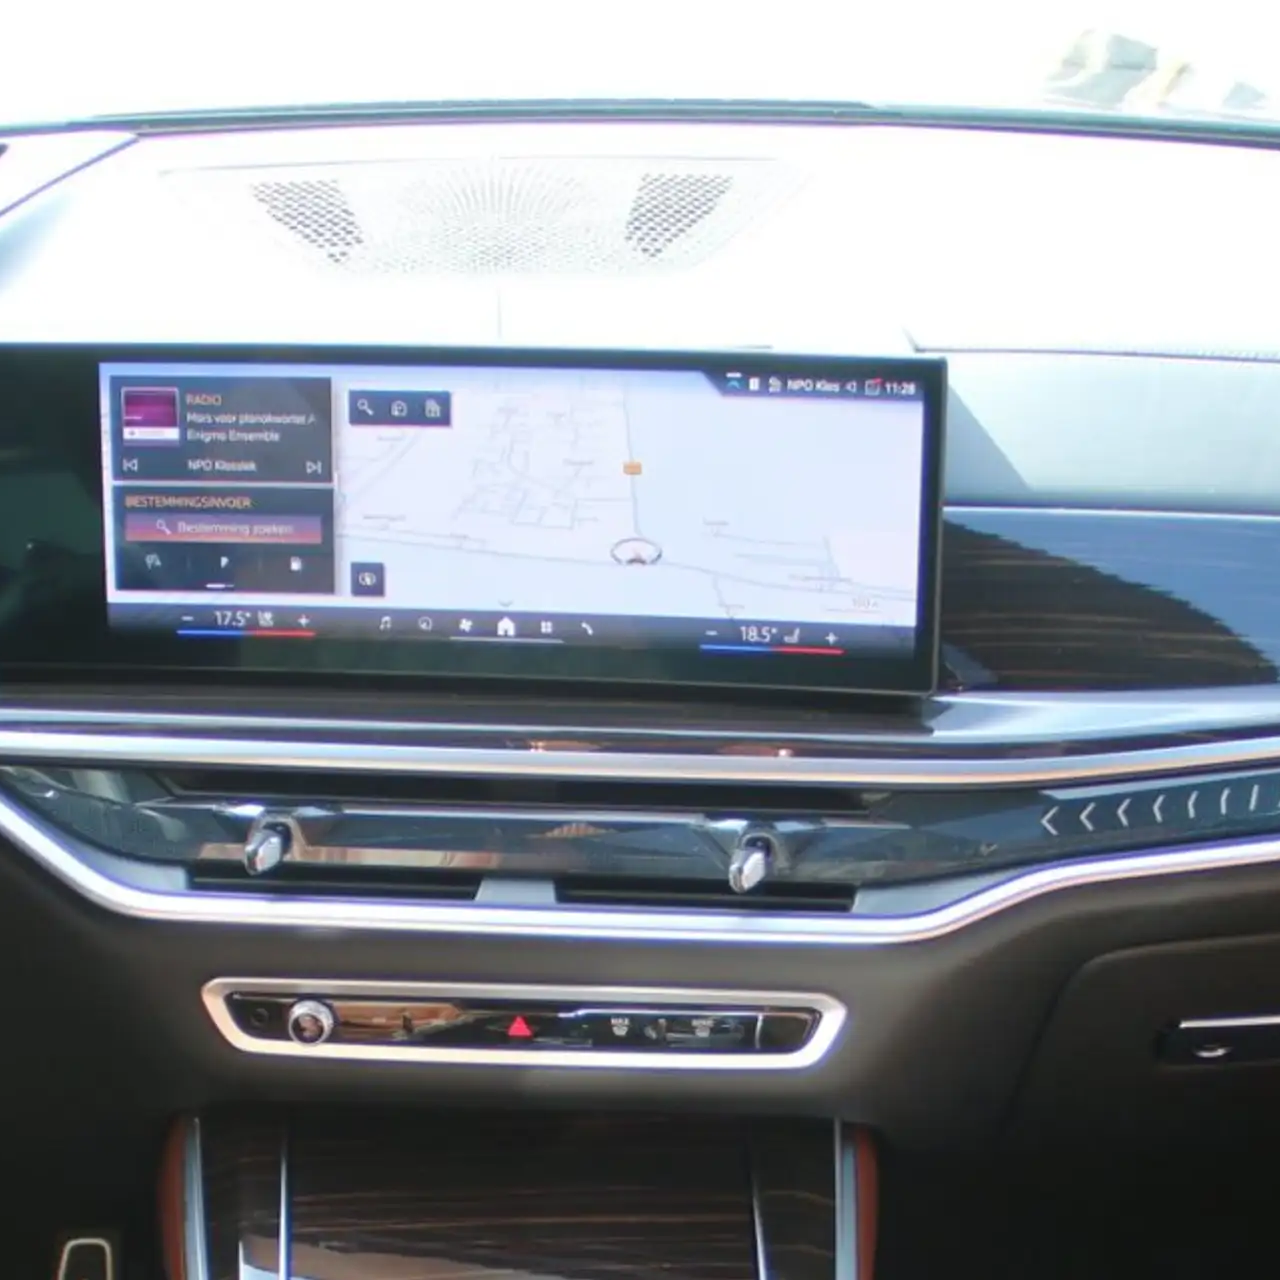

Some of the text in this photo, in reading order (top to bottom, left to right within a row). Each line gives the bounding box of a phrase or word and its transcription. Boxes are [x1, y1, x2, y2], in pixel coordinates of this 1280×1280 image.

[787, 379, 813, 391] NPO
[186, 394, 221, 405] RADIO
[188, 459, 212, 471] NPO
[178, 521, 250, 537] Bestemming
